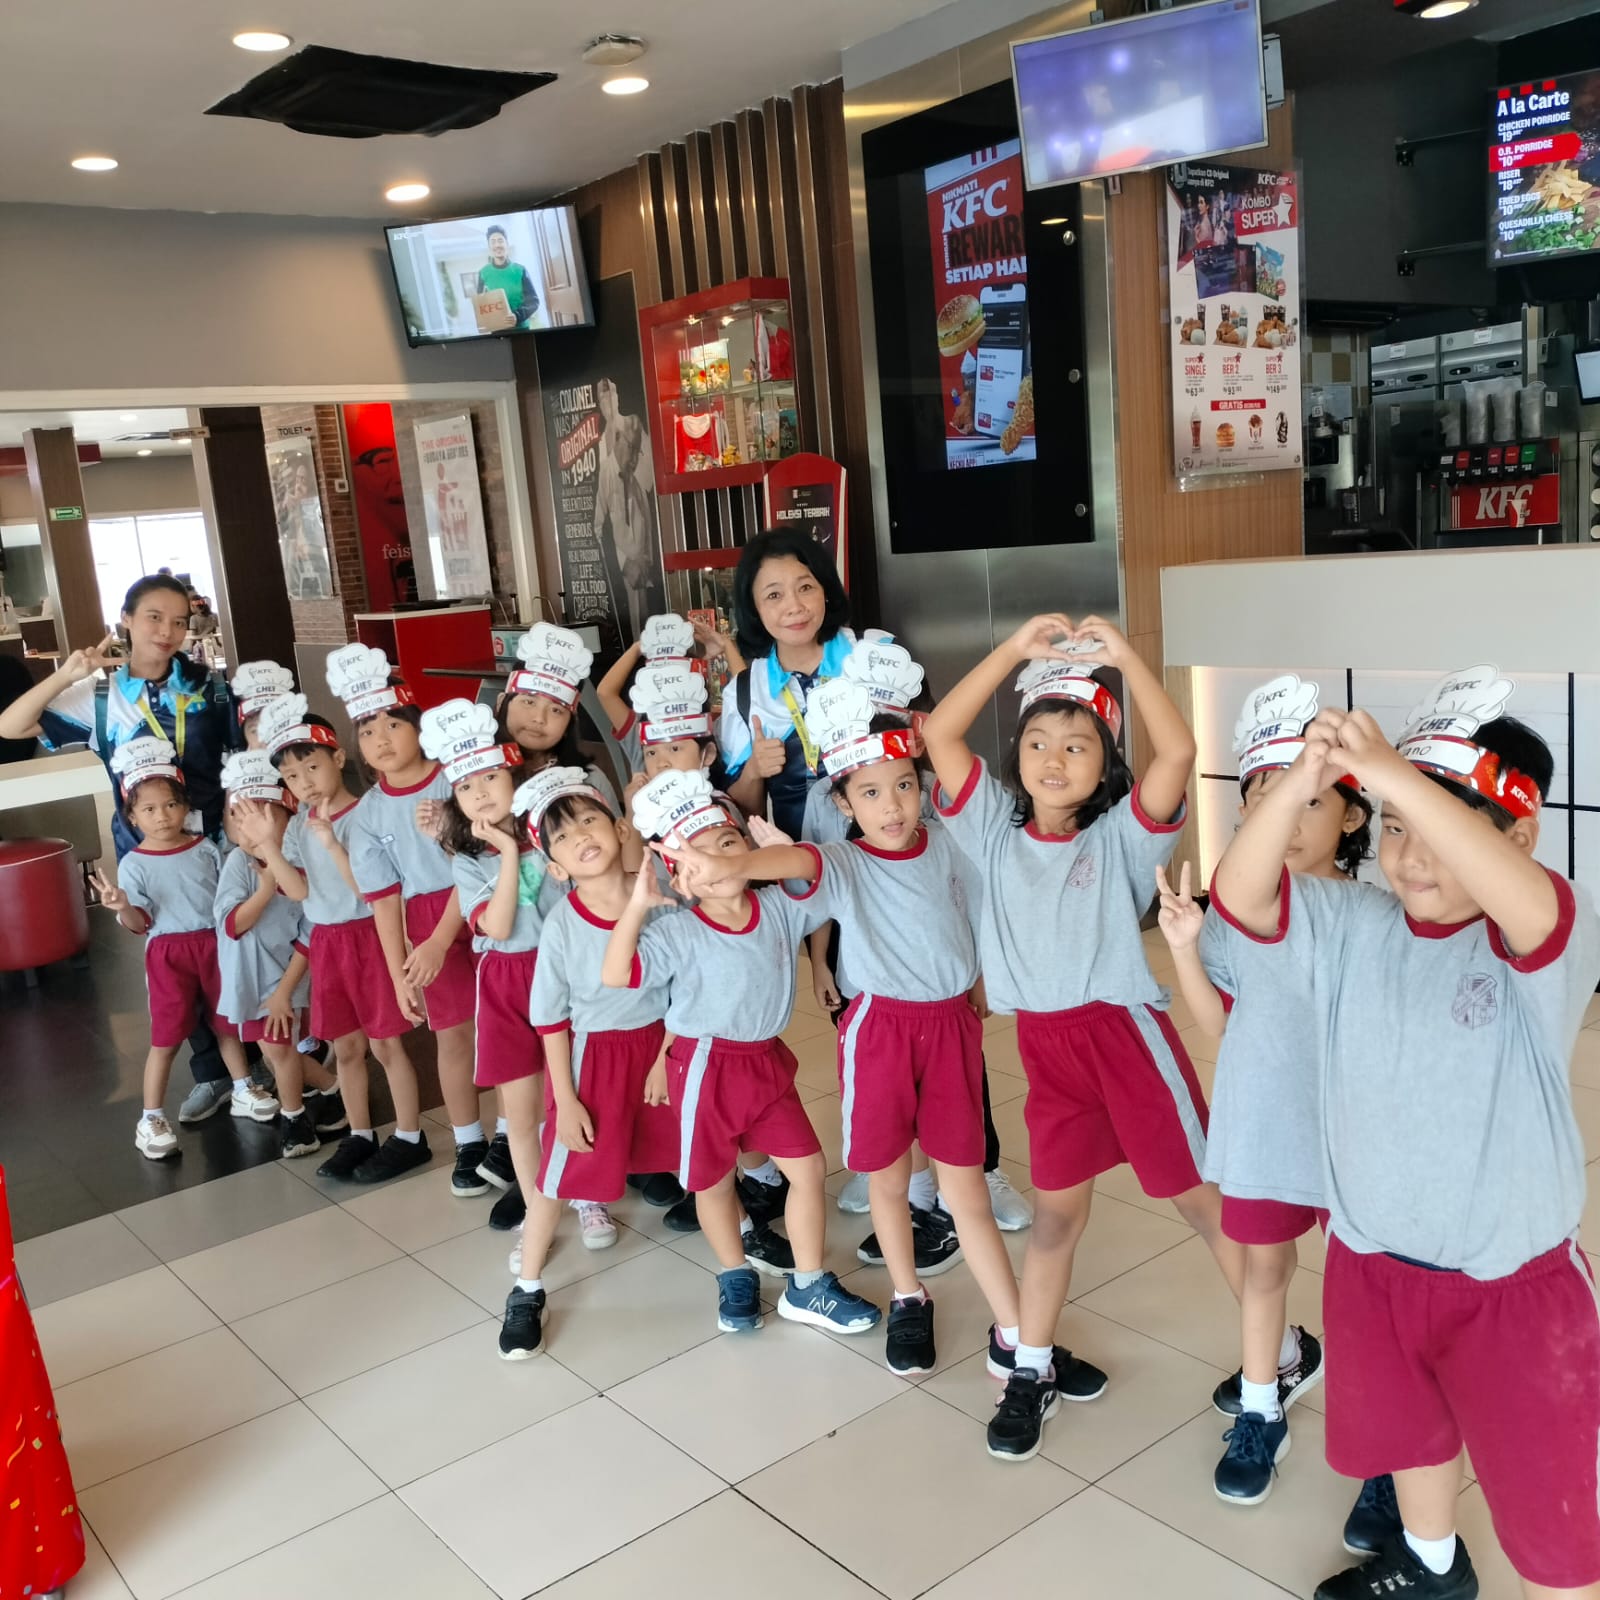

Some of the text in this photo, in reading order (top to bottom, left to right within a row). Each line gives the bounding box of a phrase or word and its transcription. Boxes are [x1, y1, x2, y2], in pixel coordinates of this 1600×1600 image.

[1497, 91, 1570, 117] A la Carte
[1498, 112, 1571, 132] CHICKEN PORRIDGE
[1514, 139, 1553, 154] PORRIDGE
[1258, 173, 1276, 185] KFC
[942, 178, 978, 204] NIKMATI
[942, 179, 1009, 234] KFC
[1241, 195, 1271, 210] KOMBO
[1498, 195, 1520, 206] FRIED
[1241, 209, 1276, 229] SUPER
[1498, 215, 1544, 231] QUESADILLA
[950, 213, 1024, 268] REWAR
[945, 261, 994, 284] SETIAP
[479, 301, 504, 315] KFC
[1184, 364, 1207, 376] SINGLE
[1222, 364, 1234, 375] BER
[1265, 363, 1277, 374] BER
[560, 384, 596, 413] COLONEL
[1219, 401, 1243, 412] GRATIS
[278, 427, 304, 437] TOILET
[553, 414, 571, 438] WAS
[561, 416, 599, 464] ORIGINAL
[561, 447, 596, 486] IN 1940
[1475, 484, 1534, 520] KFC
[662, 623, 677, 631] KFC
[555, 639, 576, 651] KFC
[656, 646, 676, 656] CHEF
[346, 654, 364, 666] KFC
[879, 657, 901, 669] KFC
[543, 662, 569, 678] CHEF
[1042, 666, 1074, 680] CHEF
[350, 679, 373, 694] CHEF
[664, 675, 684, 685] KFC
[1450, 679, 1482, 691] KFC
[255, 685, 276, 694] CHEF
[1264, 688, 1288, 704] KFC
[664, 703, 689, 715] CHEF
[447, 710, 468, 724] KFC
[1418, 717, 1457, 732] CHEF
[831, 725, 853, 743] CHEF
[1251, 723, 1282, 744] CHEF
[453, 738, 479, 754] CHEF
[453, 755, 485, 775] Brielle
[242, 776, 265, 784] CHEF
[658, 778, 679, 795] KFC
[1509, 784, 1529, 805] KFC
[670, 799, 697, 820] CHEF
